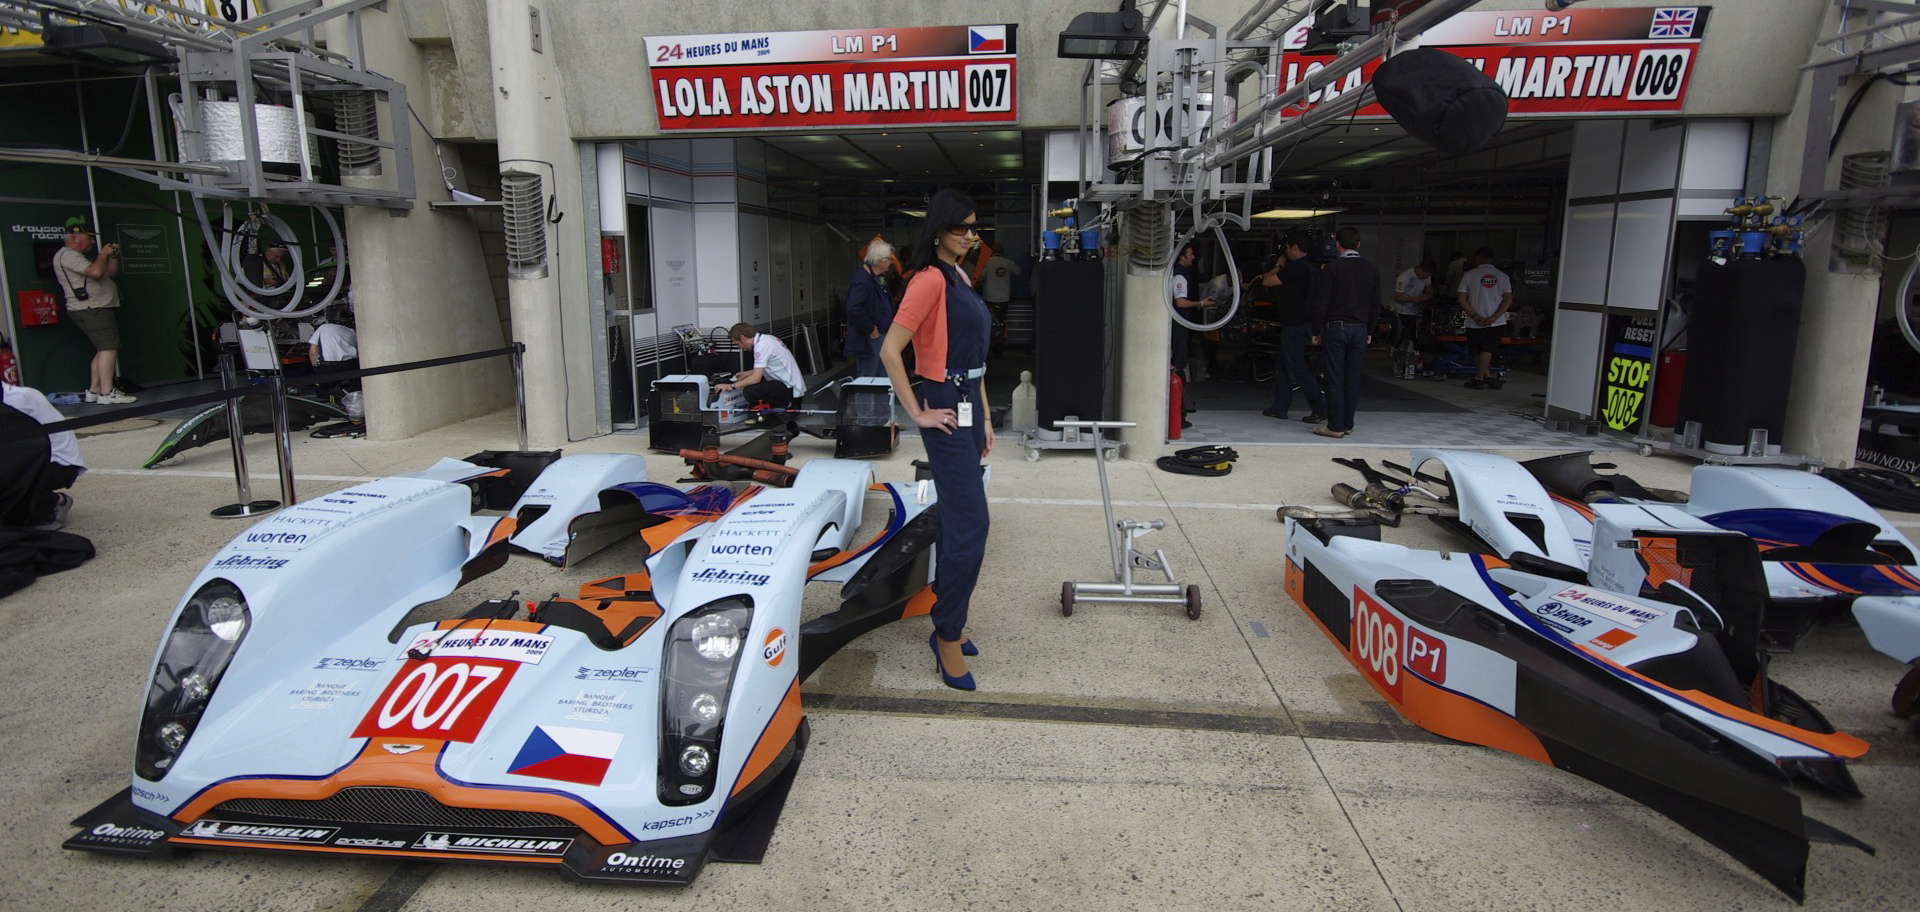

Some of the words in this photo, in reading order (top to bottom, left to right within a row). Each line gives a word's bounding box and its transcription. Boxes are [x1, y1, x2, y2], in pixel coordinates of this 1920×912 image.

[1494, 17, 1531, 36] LM
[1540, 15, 1571, 34] P1
[656, 44, 684, 62] 24
[686, 43, 721, 59] HEURES
[724, 41, 737, 53] DU
[741, 37, 769, 52] MANS
[831, 35, 863, 54] LM
[872, 33, 898, 53] P1
[757, 49, 771, 57] 2009
[1494, 55, 1632, 99] MARTIN
[1634, 53, 1682, 97] 008
[658, 77, 733, 118] LOLA
[740, 74, 833, 116] ASTON
[843, 70, 960, 112] MARTIN
[969, 68, 1008, 109] 007
[12, 225, 66, 234] drayson
[1624, 327, 1656, 343] RESET
[1608, 389, 1637, 426] 008
[1856, 447, 1881, 463] MAR
[1879, 454, 1920, 473] ASTON
[272, 516, 334, 527] HACKETT
[246, 532, 307, 544] worten
[711, 544, 773, 556] worten
[215, 555, 290, 570] Sebring
[692, 568, 771, 587] Sebring
[1557, 589, 1588, 600] 24
[1580, 597, 1616, 609] HEURES
[1612, 604, 1630, 613] DU
[1626, 609, 1660, 621] MANS
[441, 638, 489, 649] HEURES
[489, 638, 509, 647] DU
[510, 638, 550, 650] MANS
[763, 634, 789, 661] Gulf
[1357, 601, 1398, 686] 008
[1410, 636, 1441, 673] P1
[333, 657, 387, 671] zepter
[593, 666, 649, 681] zepter
[377, 662, 503, 730] 007
[583, 693, 616, 701] BANQUE
[572, 707, 609, 715] STURDZA
[592, 700, 634, 710] BROTHERS
[132, 786, 155, 801] apsch
[224, 824, 331, 839] MICHELIN
[642, 815, 693, 832] kapsch
[92, 823, 165, 841] Ontime
[82, 836, 153, 846] AUTOMOTIVE
[453, 836, 565, 851] MICHELIN
[606, 852, 686, 869] Ontime
[600, 867, 681, 876] AUTOMOTIVE
